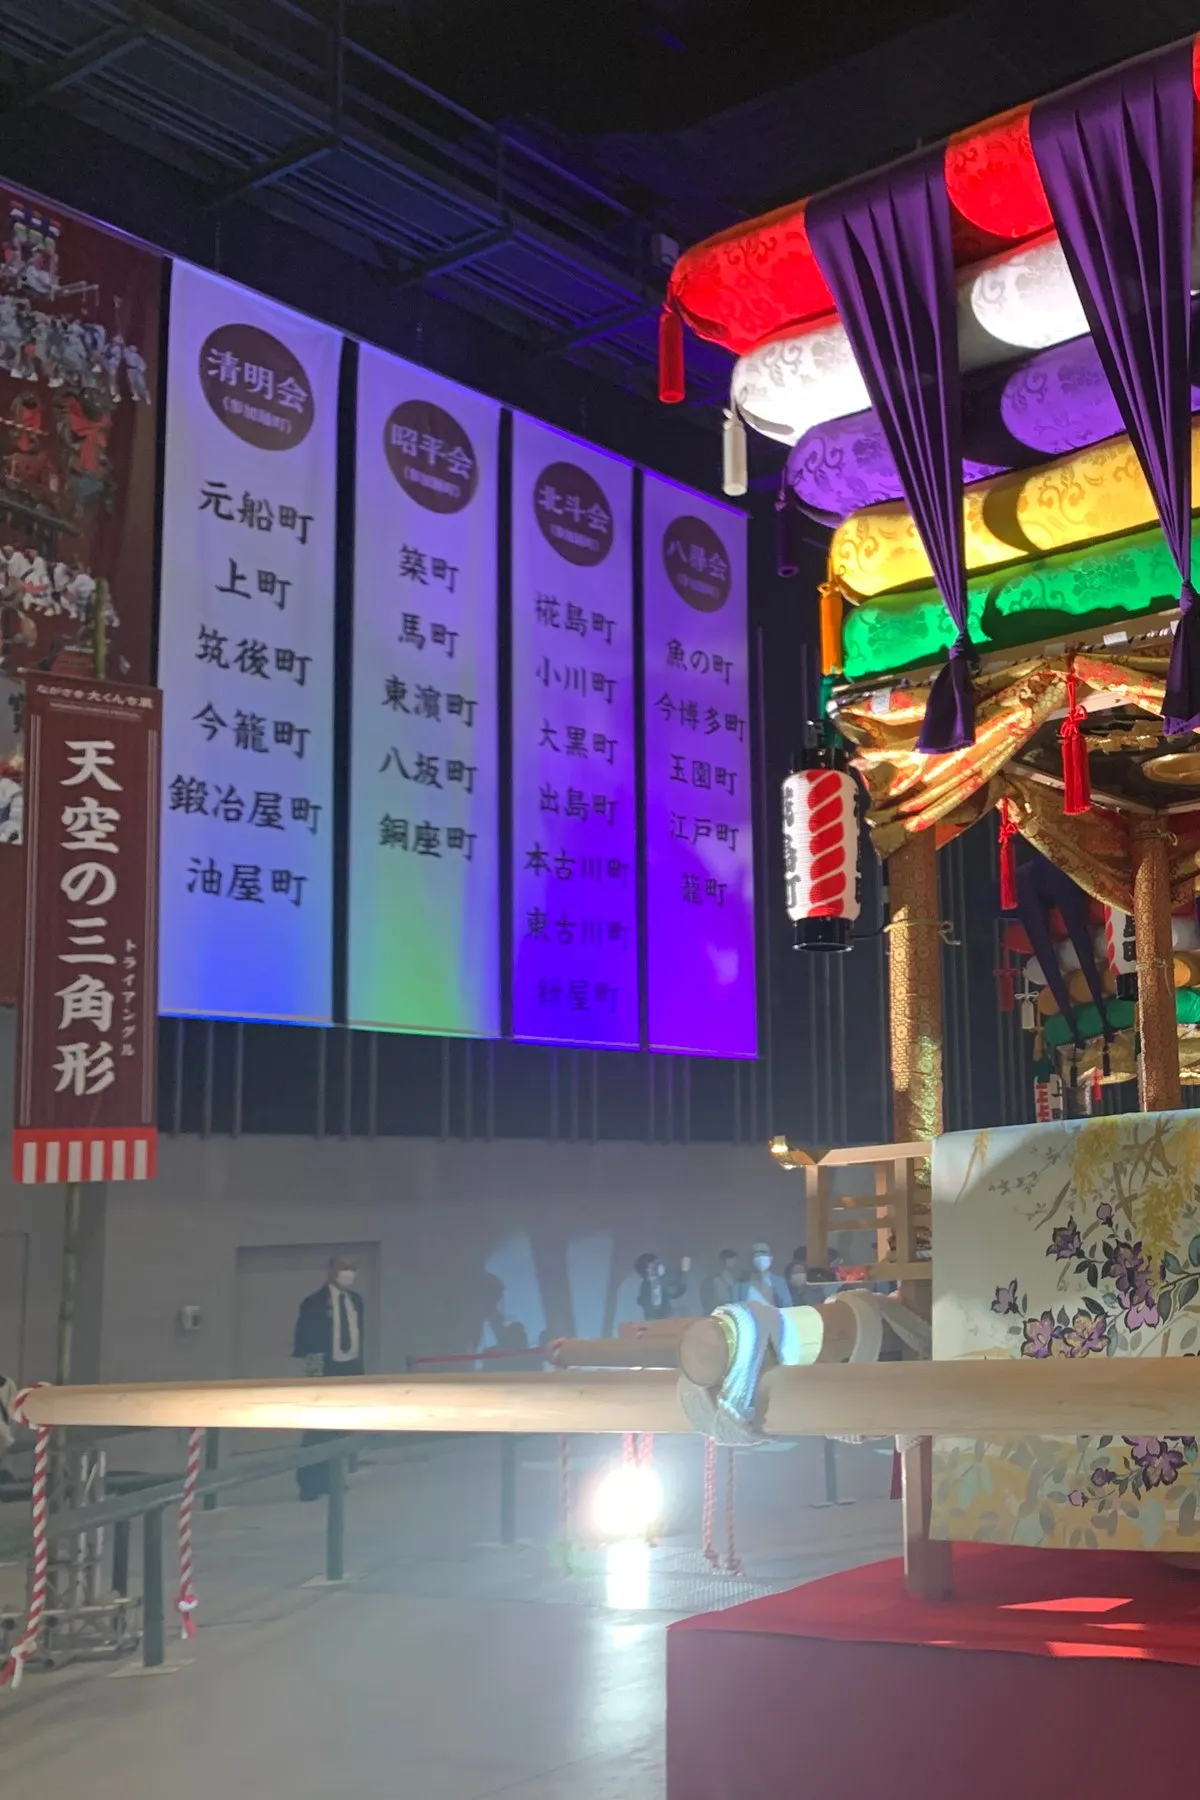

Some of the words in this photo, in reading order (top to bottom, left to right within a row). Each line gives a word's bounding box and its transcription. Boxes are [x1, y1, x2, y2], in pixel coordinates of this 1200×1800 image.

[207, 348, 309, 413] 清明会
[391, 424, 473, 480] 昭平会
[198, 480, 314, 545] 元船町
[539, 485, 610, 534] 北斗会
[215, 557, 292, 611] 上町
[399, 544, 459, 593] 築町
[195, 623, 313, 686] 筑後町
[398, 612, 459, 659] 馬町
[536, 655, 616, 704] 小川町
[666, 639, 734, 685] 魚の町
[381, 674, 478, 727] 東濱町
[655, 692, 746, 743] 今博多町
[192, 702, 311, 759] 今籠町
[538, 718, 618, 766] 大黒町
[379, 746, 478, 794] 八坂町
[670, 753, 737, 796] 玉園町
[168, 774, 322, 836] 鍛冶屋町
[540, 782, 619, 827] 出島町
[379, 813, 477, 861] 銅座町
[670, 811, 739, 852] 江戸町
[187, 856, 308, 907] 油屋町
[524, 842, 629, 889] 本古川町
[52, 739, 123, 1096] 天空の三角形
